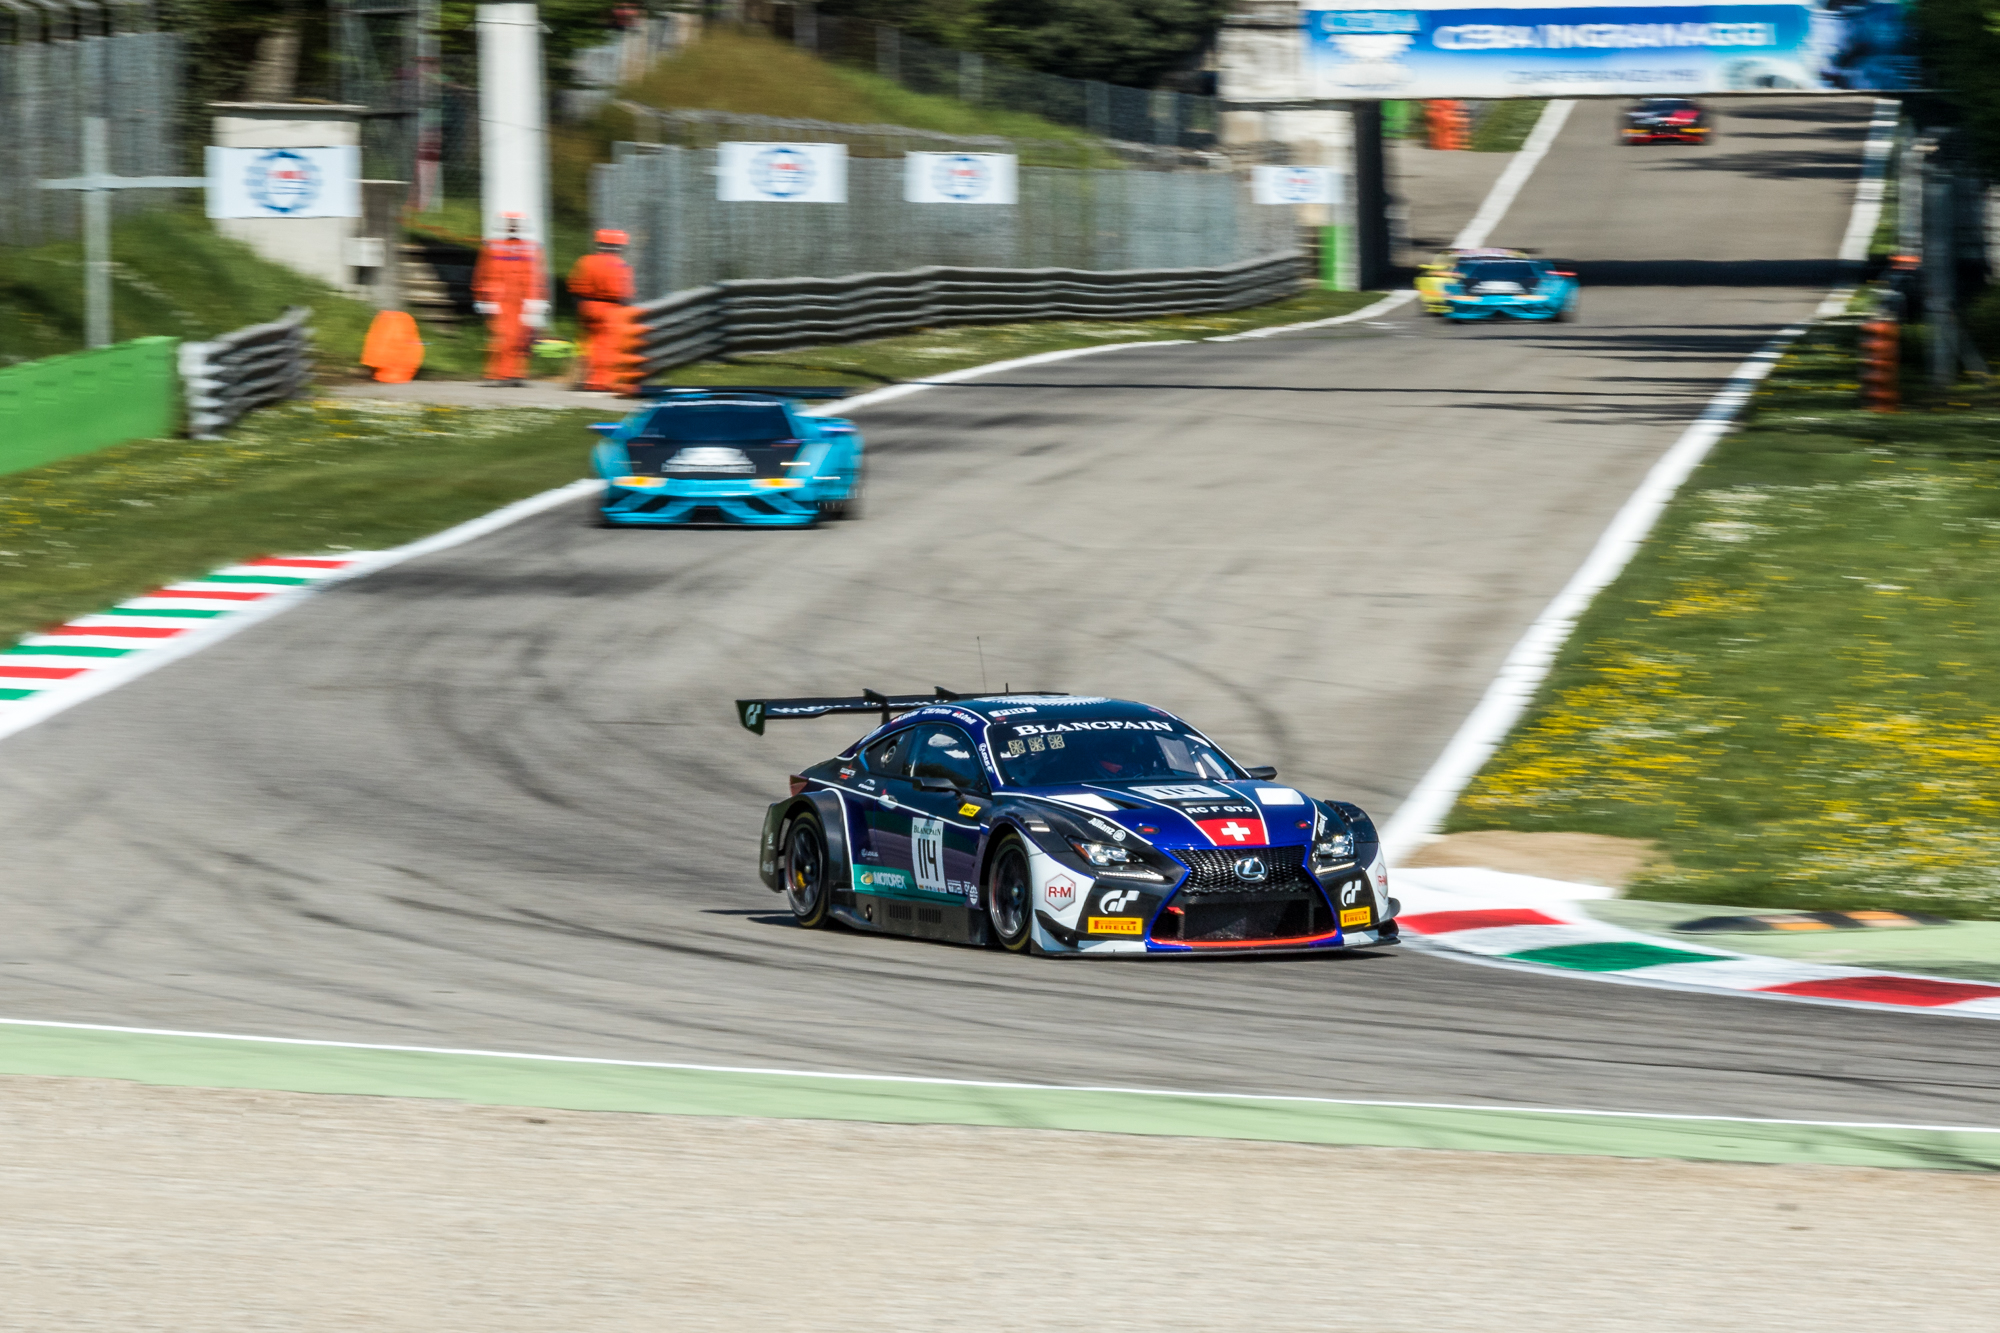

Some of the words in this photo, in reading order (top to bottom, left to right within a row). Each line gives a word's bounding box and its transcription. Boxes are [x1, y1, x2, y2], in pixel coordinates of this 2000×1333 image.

[1012, 720, 1173, 736] BLANCPAIN
[1184, 806, 1209, 814] RC
[1209, 805, 1220, 813] F
[1223, 805, 1253, 813] GT3
[913, 825, 941, 836] BLANCPAIN
[1088, 817, 1116, 836] Allianz
[917, 838, 939, 882] 114
[873, 871, 907, 889] MOTOREX
[1048, 886, 1072, 898] R-M
[1344, 910, 1368, 923] PIRELLI
[1093, 920, 1137, 931] PIRELLI
